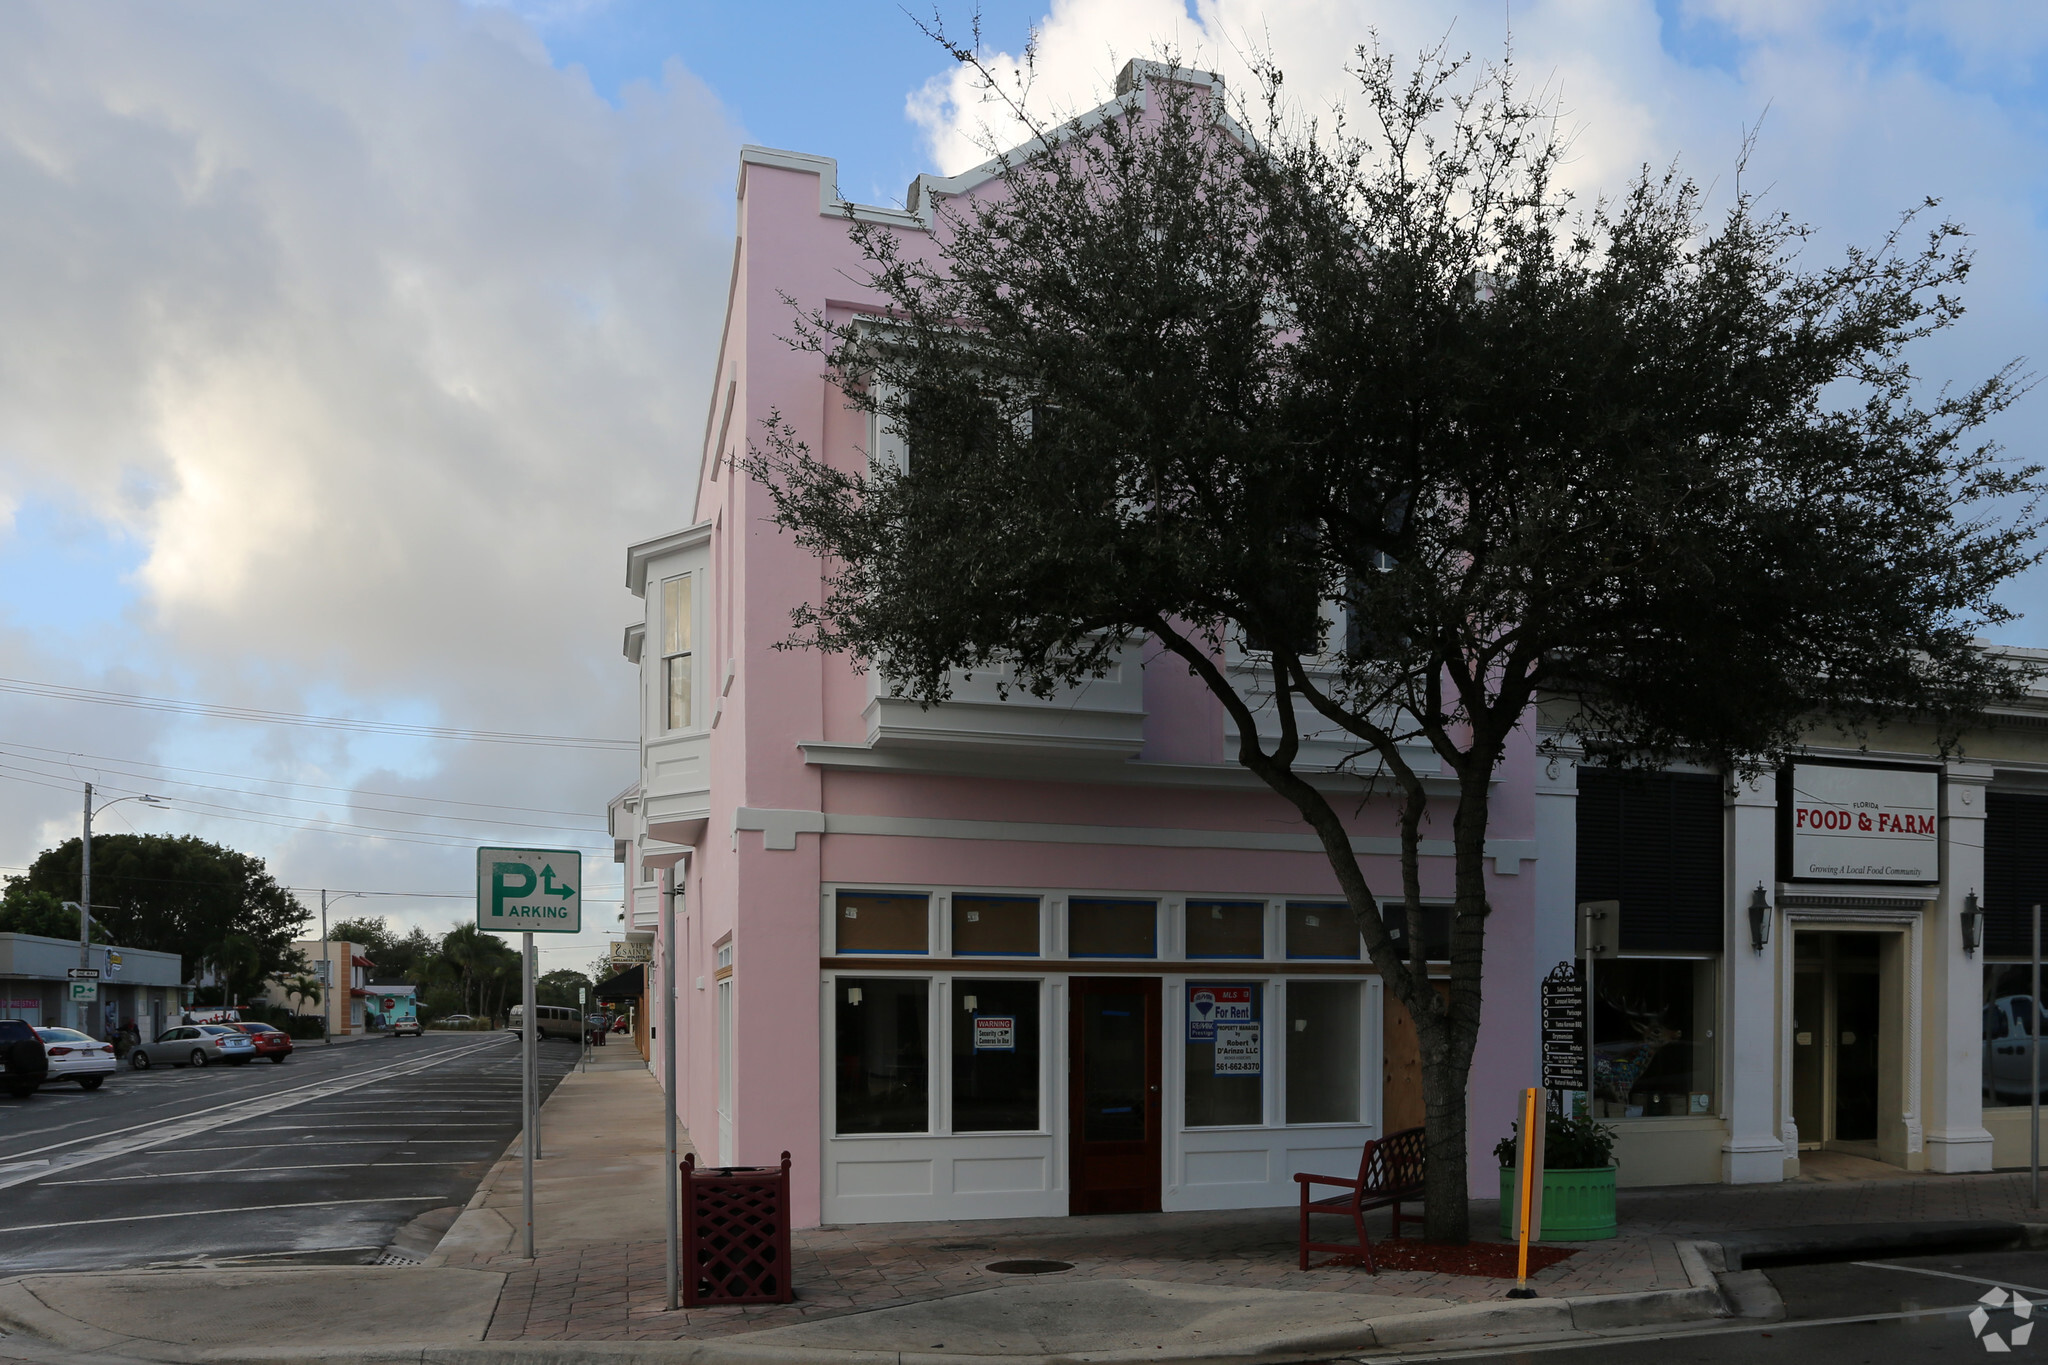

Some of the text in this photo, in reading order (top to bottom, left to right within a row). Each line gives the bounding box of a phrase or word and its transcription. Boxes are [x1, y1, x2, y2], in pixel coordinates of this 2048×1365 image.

[1853, 801, 1879, 810] FLORIDA
[1796, 808, 1935, 834] FOOD & FARM
[1809, 864, 1922, 877] Growing A Local Food Community
[1215, 1006, 1249, 1018] For Rent
